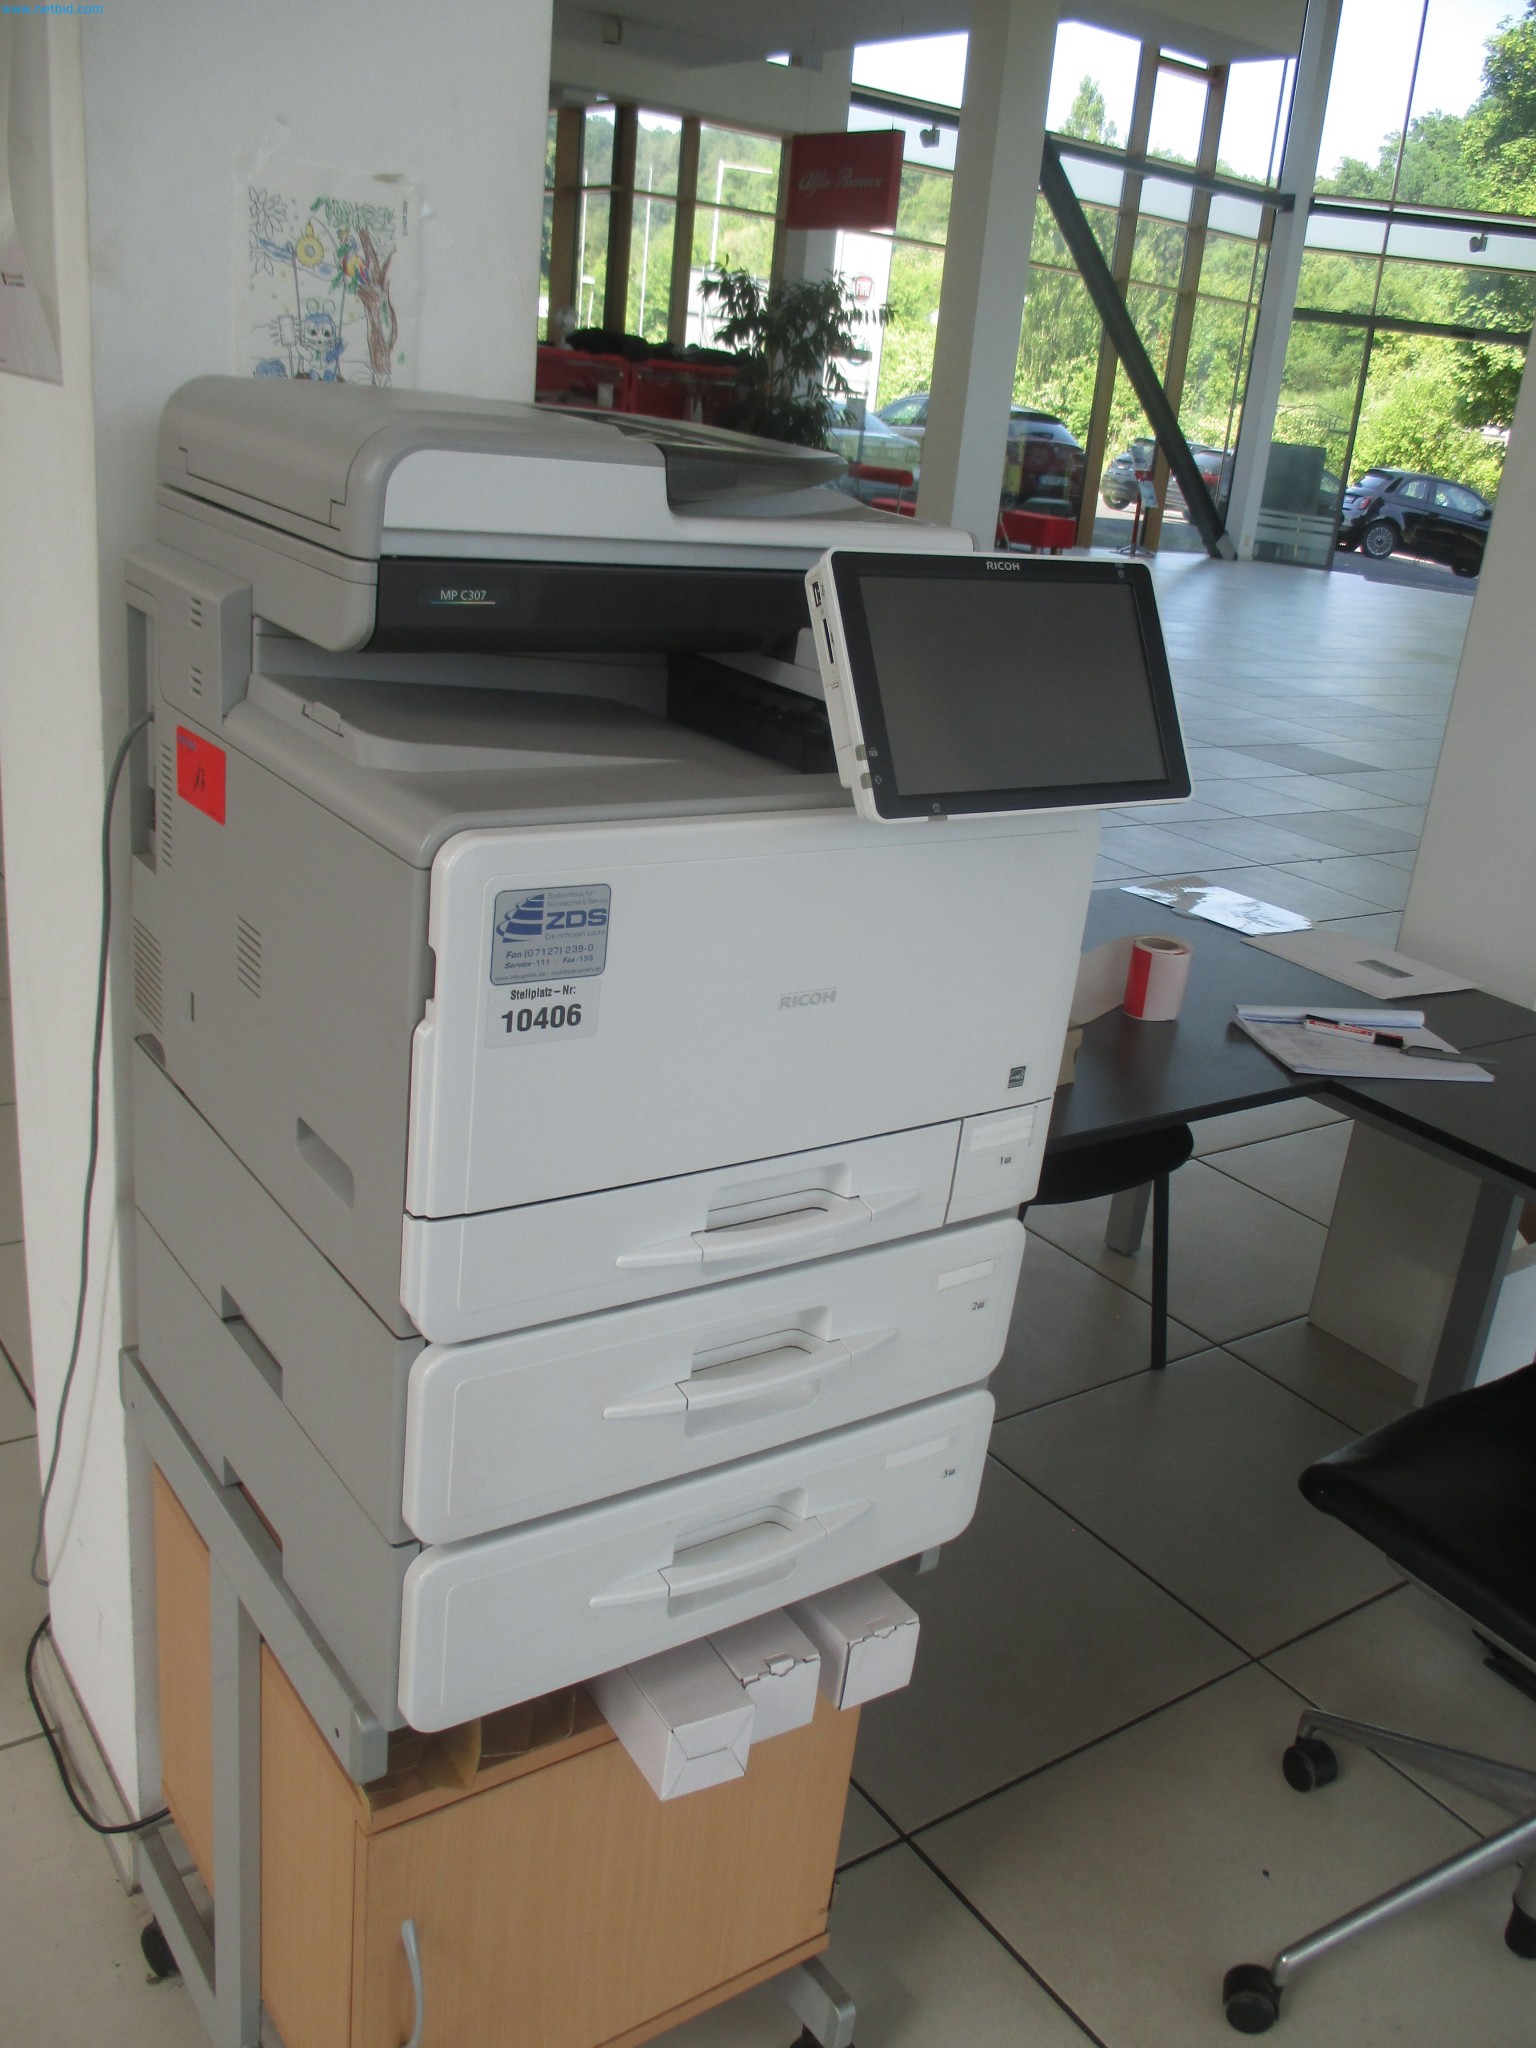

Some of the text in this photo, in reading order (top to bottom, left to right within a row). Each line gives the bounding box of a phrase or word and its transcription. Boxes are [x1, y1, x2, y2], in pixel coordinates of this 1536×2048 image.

[986, 561, 1020, 571] RICOH
[440, 590, 487, 601] MP C307
[546, 908, 608, 930] ZDS
[506, 951, 522, 959] Fon
[524, 947, 562, 958] (07127)
[505, 961, 531, 969] Service
[779, 990, 836, 1009] RICOH
[501, 1003, 582, 1033] 10406
